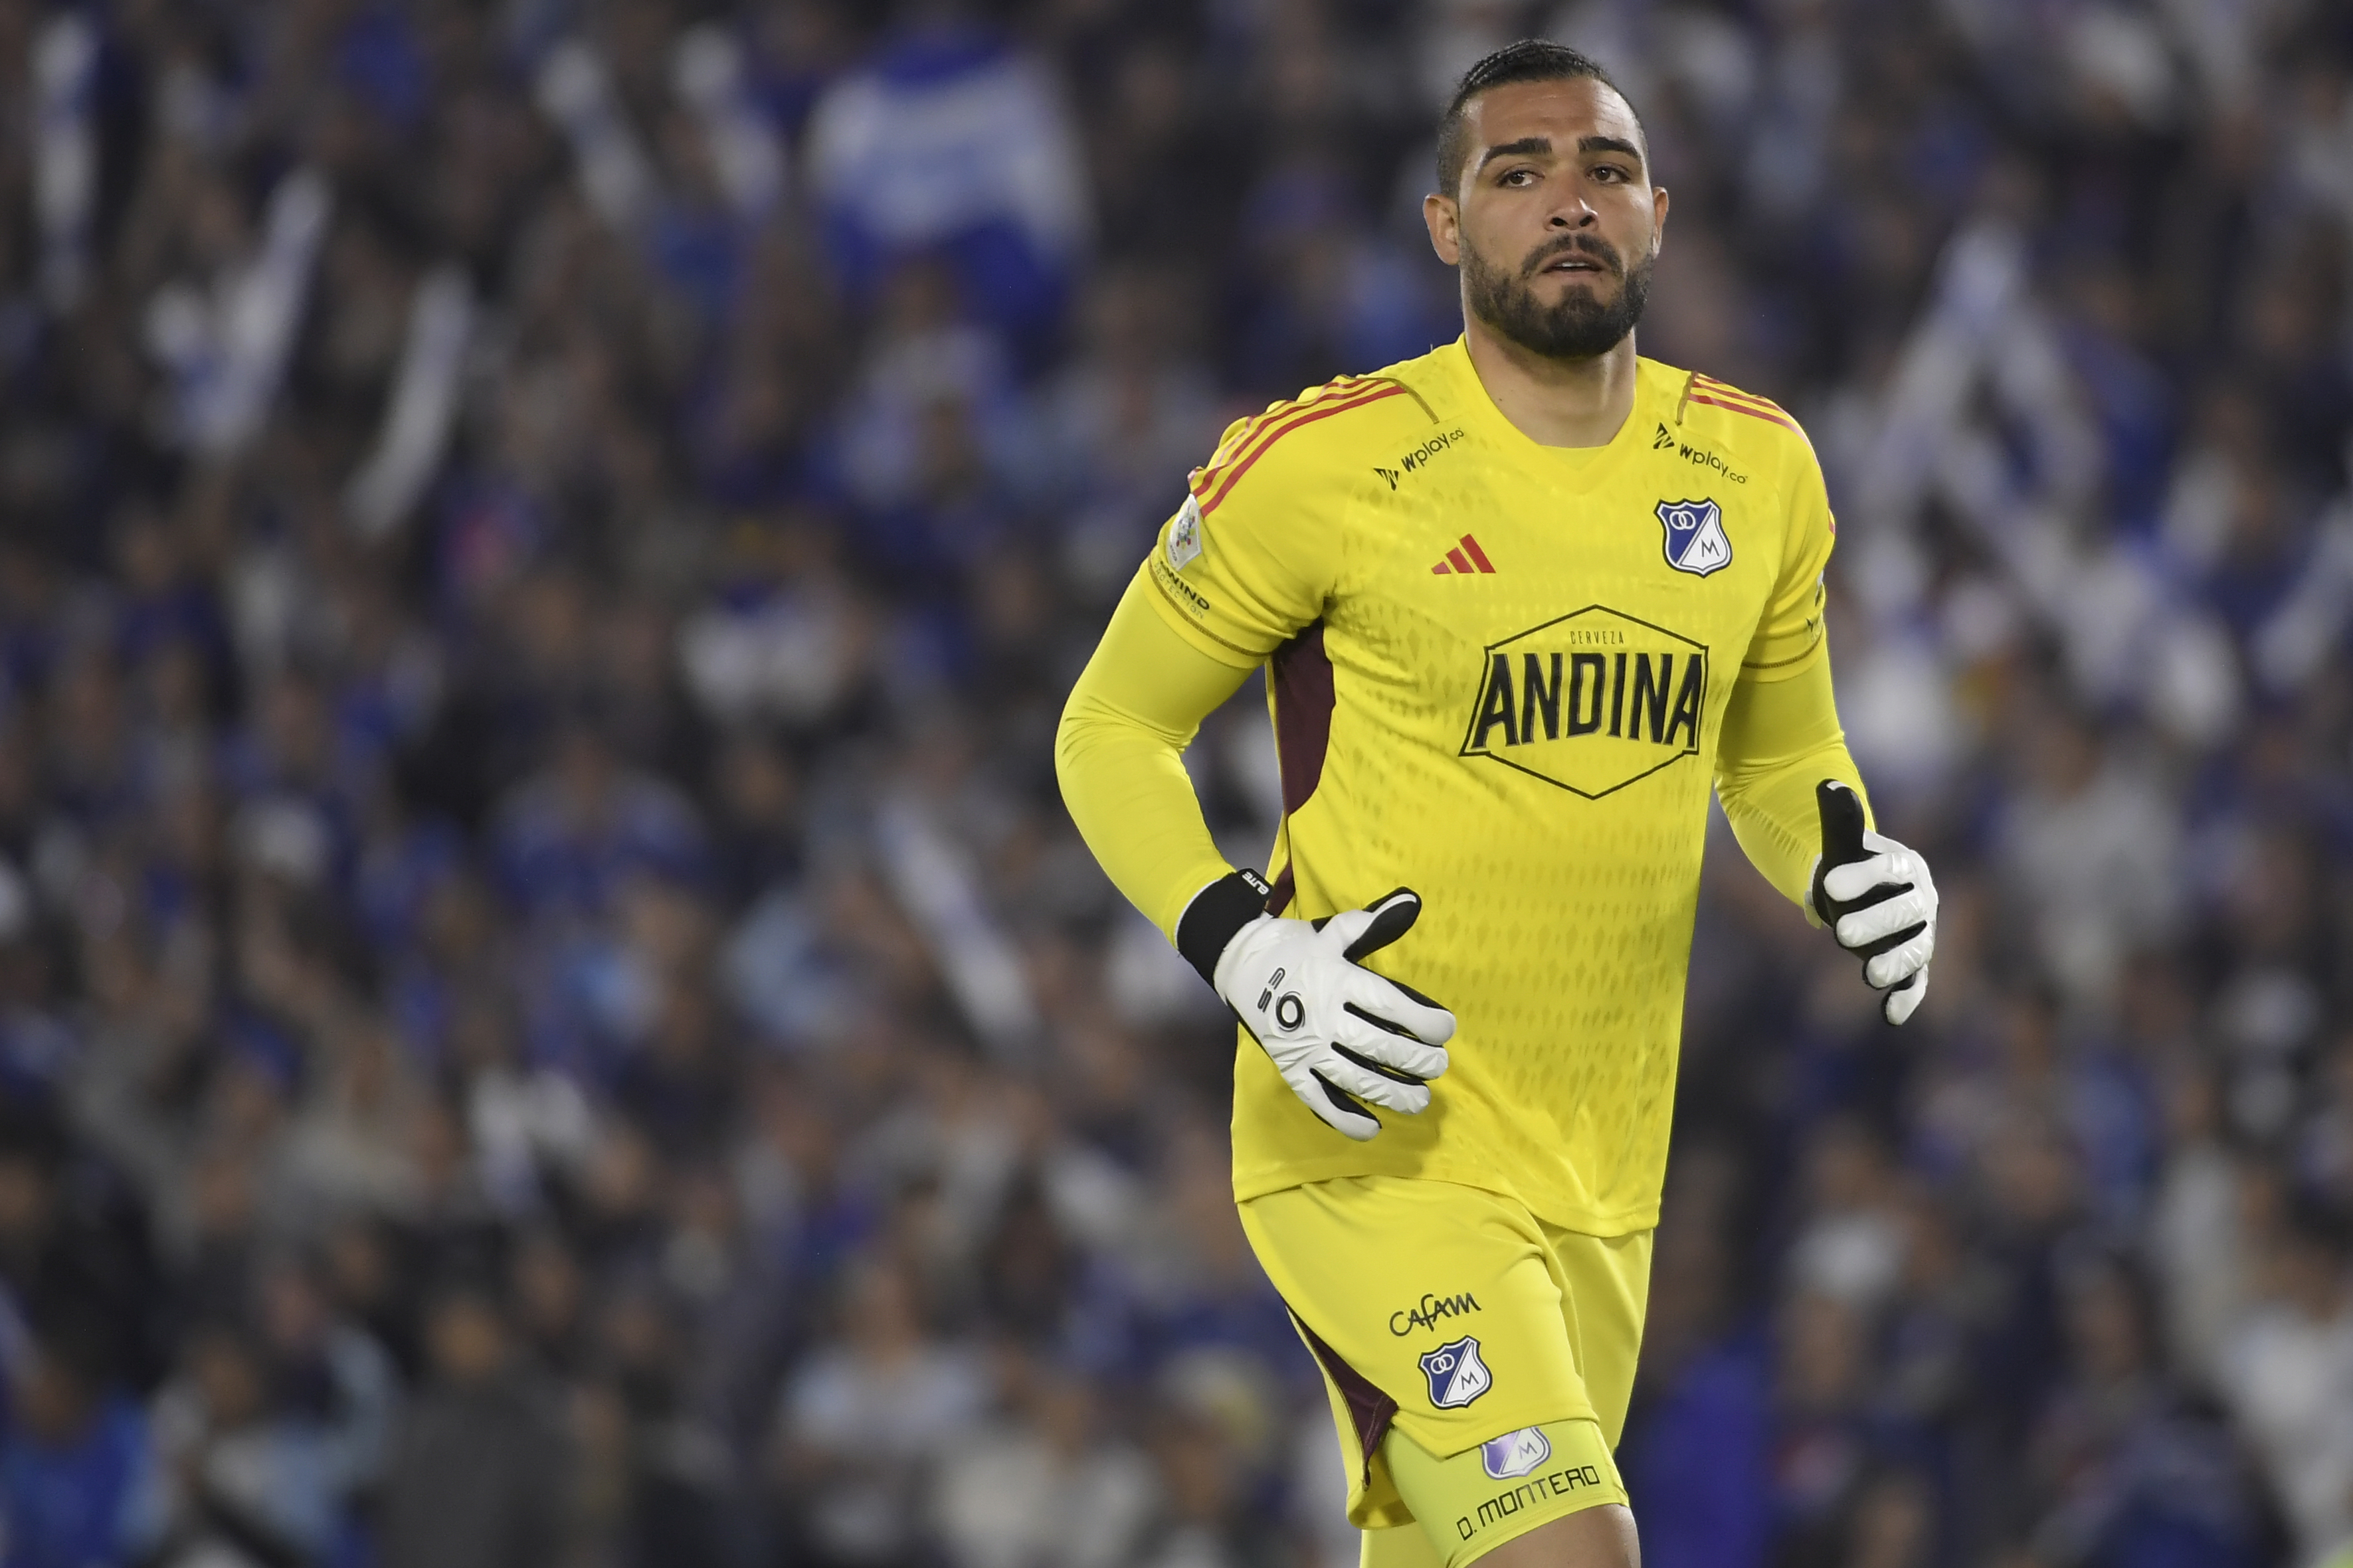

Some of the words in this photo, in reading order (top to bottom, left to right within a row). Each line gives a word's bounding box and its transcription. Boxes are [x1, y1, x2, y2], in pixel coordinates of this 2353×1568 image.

[1701, 539, 1720, 558] M
[1570, 630, 1625, 646] CERVEZA
[1470, 652, 1703, 749] ANDINA
[1242, 871, 1270, 895] ELITE
[1461, 1371, 1479, 1390] M
[1519, 1441, 1538, 1459] M
[1477, 1465, 1600, 1527] MONTERO
